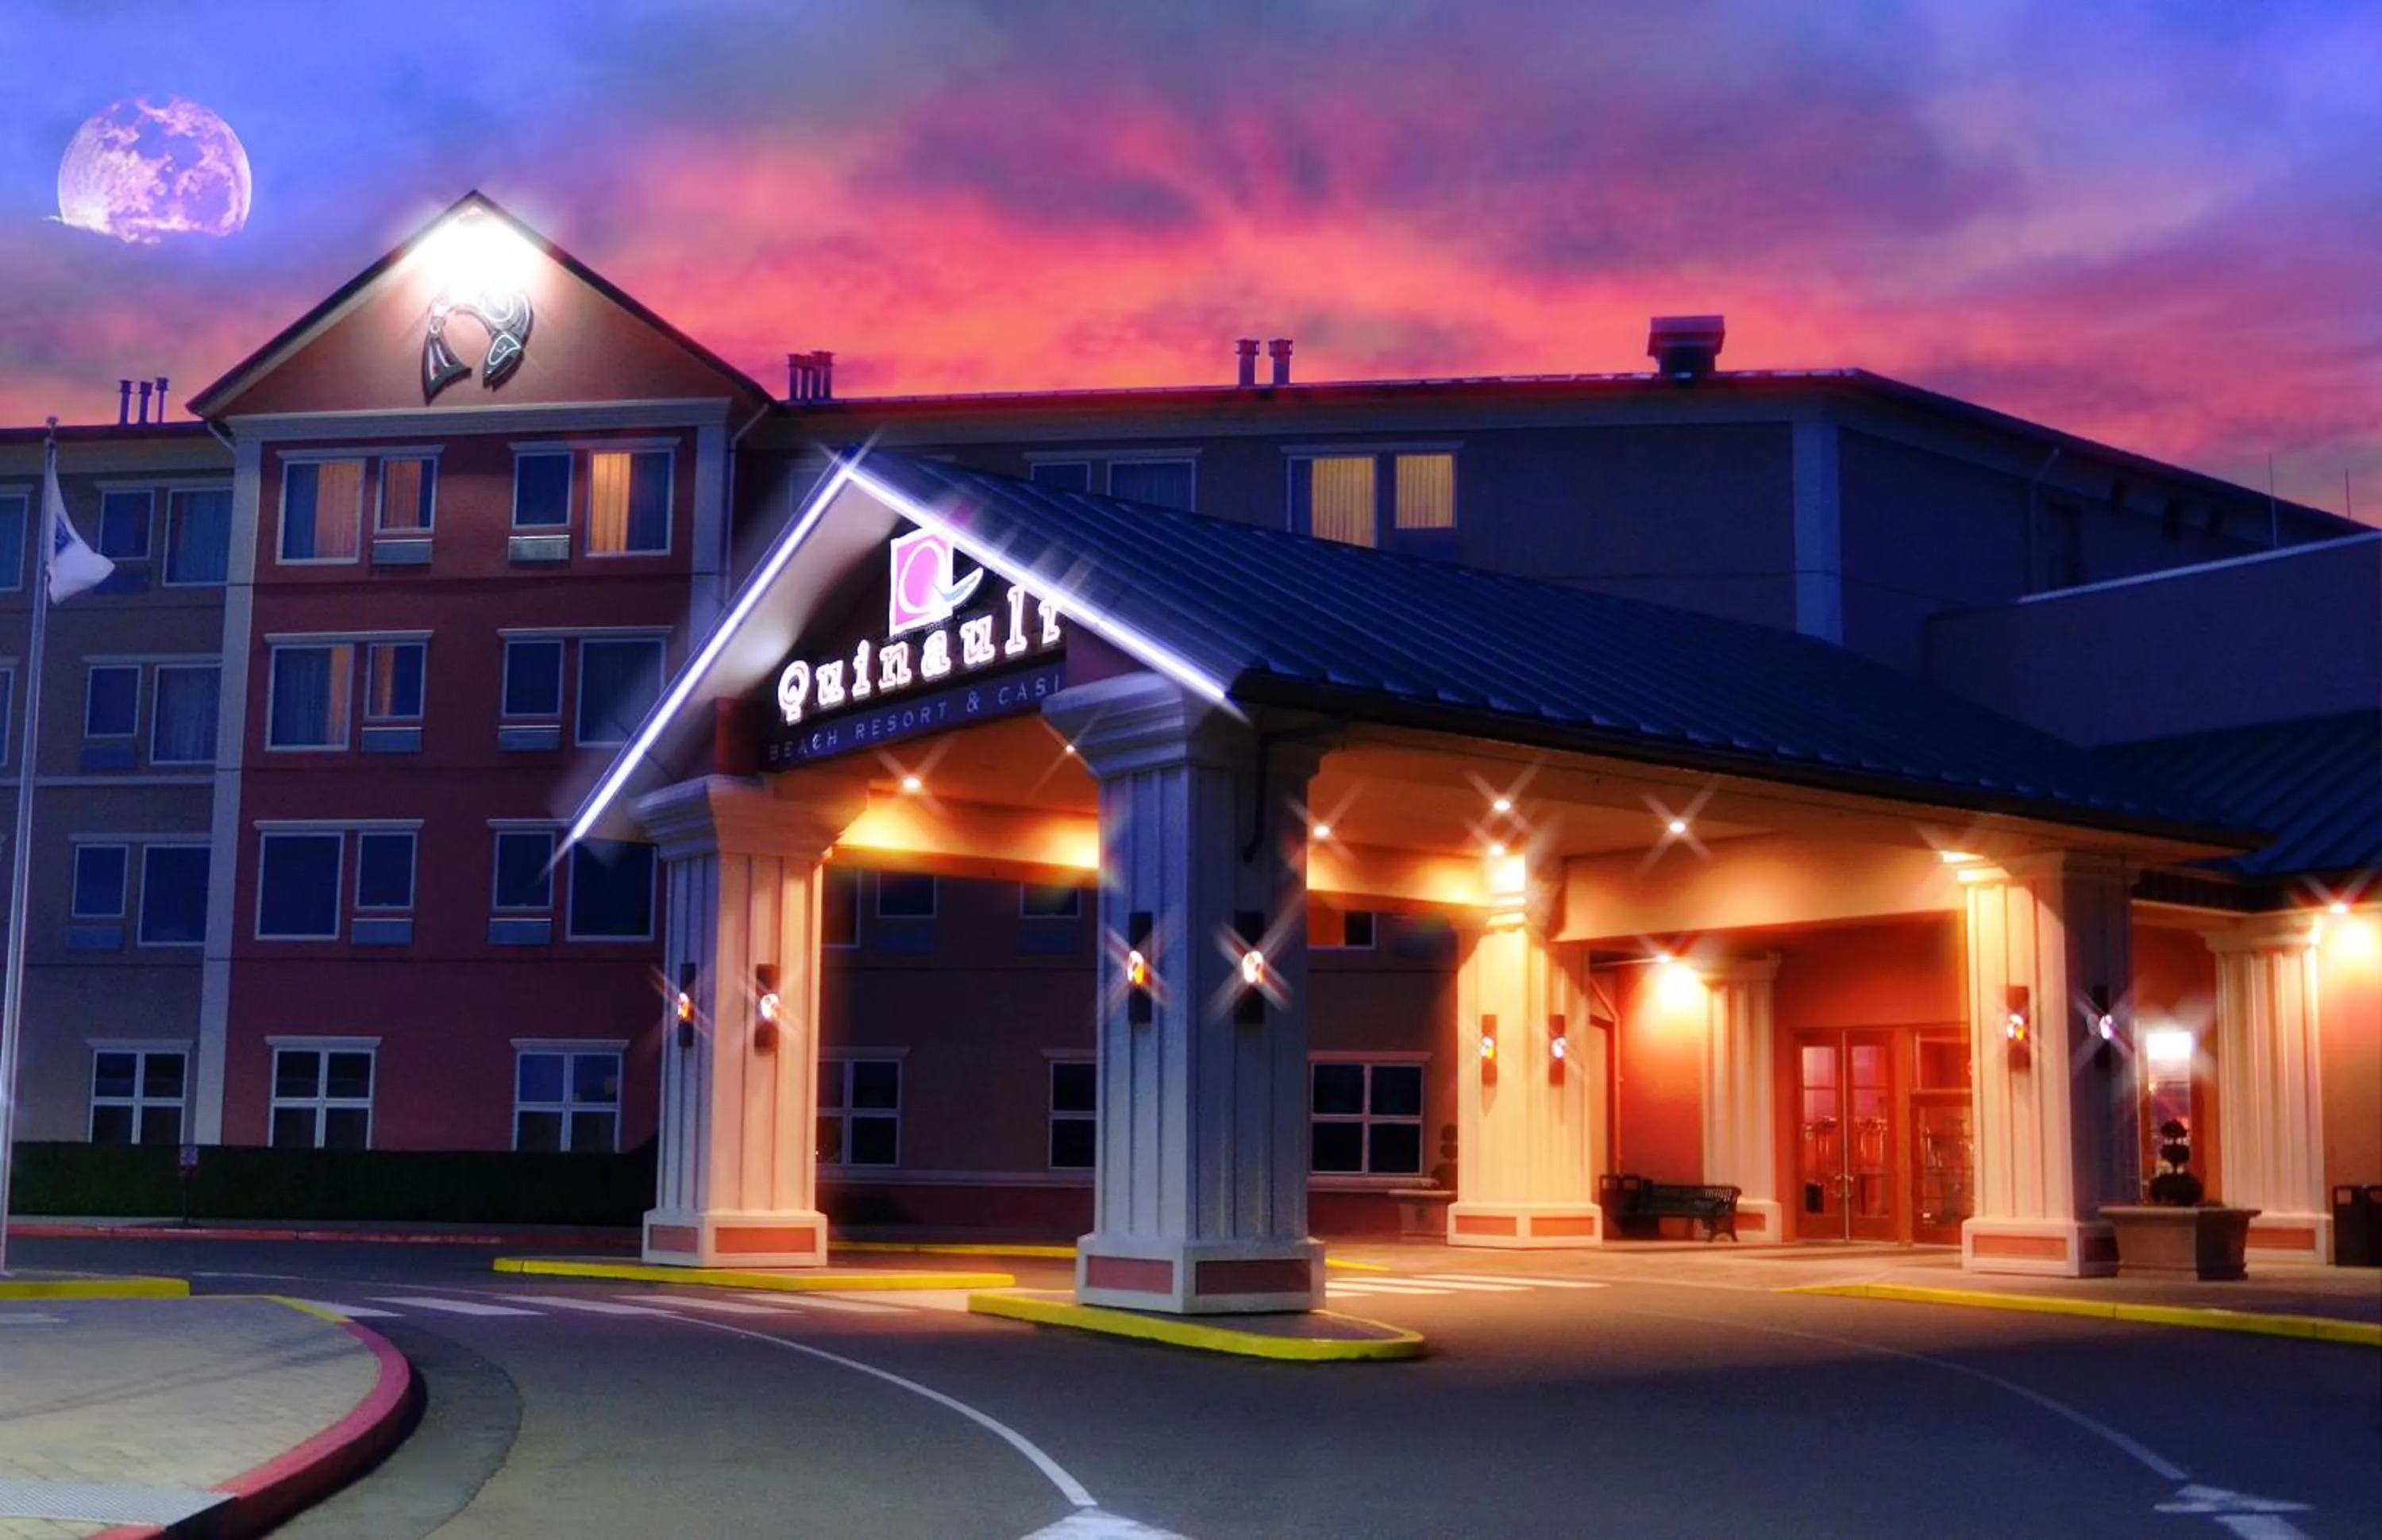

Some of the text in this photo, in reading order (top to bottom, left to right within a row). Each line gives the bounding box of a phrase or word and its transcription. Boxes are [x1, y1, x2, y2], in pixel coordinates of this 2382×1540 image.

[769, 729, 838, 761] BEACH
[854, 701, 947, 740] RESORT
[966, 690, 981, 713] &
